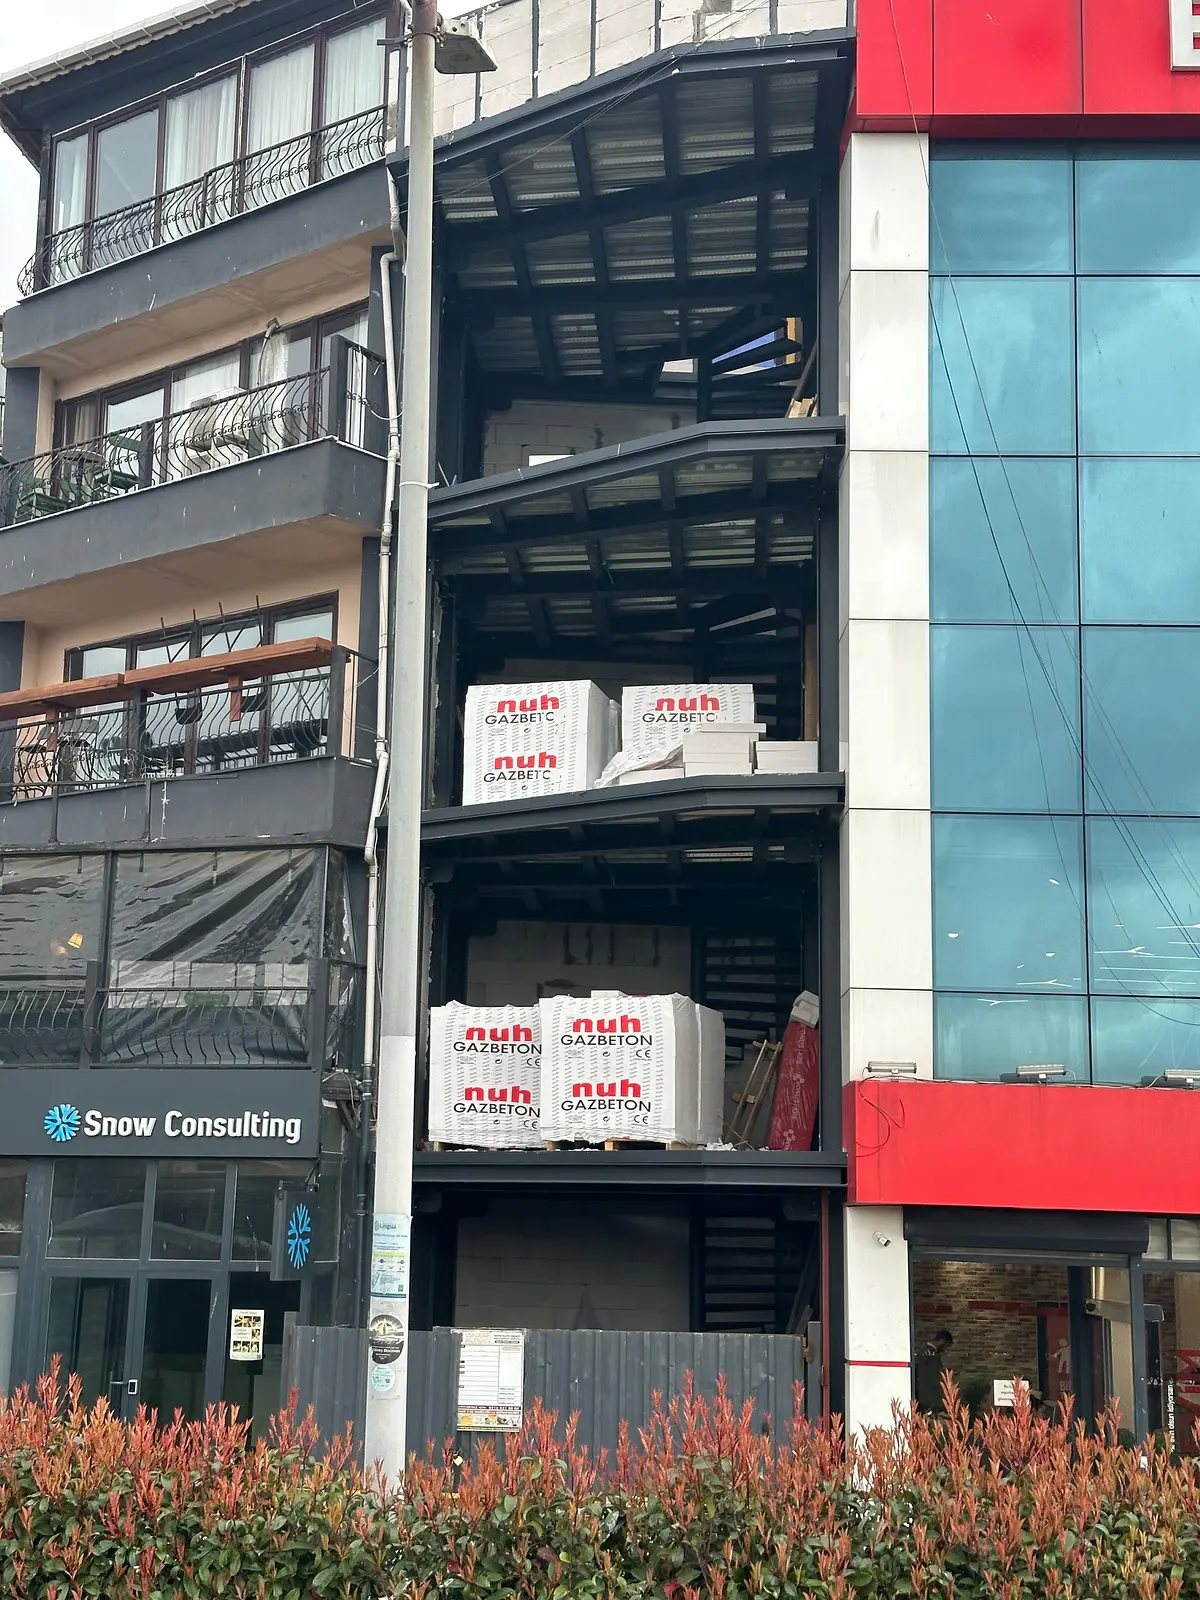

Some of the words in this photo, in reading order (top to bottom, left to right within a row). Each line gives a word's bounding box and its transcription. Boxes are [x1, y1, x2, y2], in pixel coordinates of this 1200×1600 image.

[497, 694, 560, 713] nuh
[655, 693, 720, 711] nuh
[494, 751, 557, 770] nuh
[573, 1014, 641, 1033] nuh
[465, 1024, 532, 1042] nuh
[561, 1034, 652, 1046] GAZBETON
[453, 1041, 542, 1055] GAZBETON
[464, 1085, 531, 1105] nuh
[573, 1079, 641, 1098] nuh
[453, 1103, 541, 1118] GAZBETON
[561, 1099, 651, 1113] GAZBETON
[83, 1110, 157, 1137] Snow
[163, 1110, 302, 1144] Consulting
